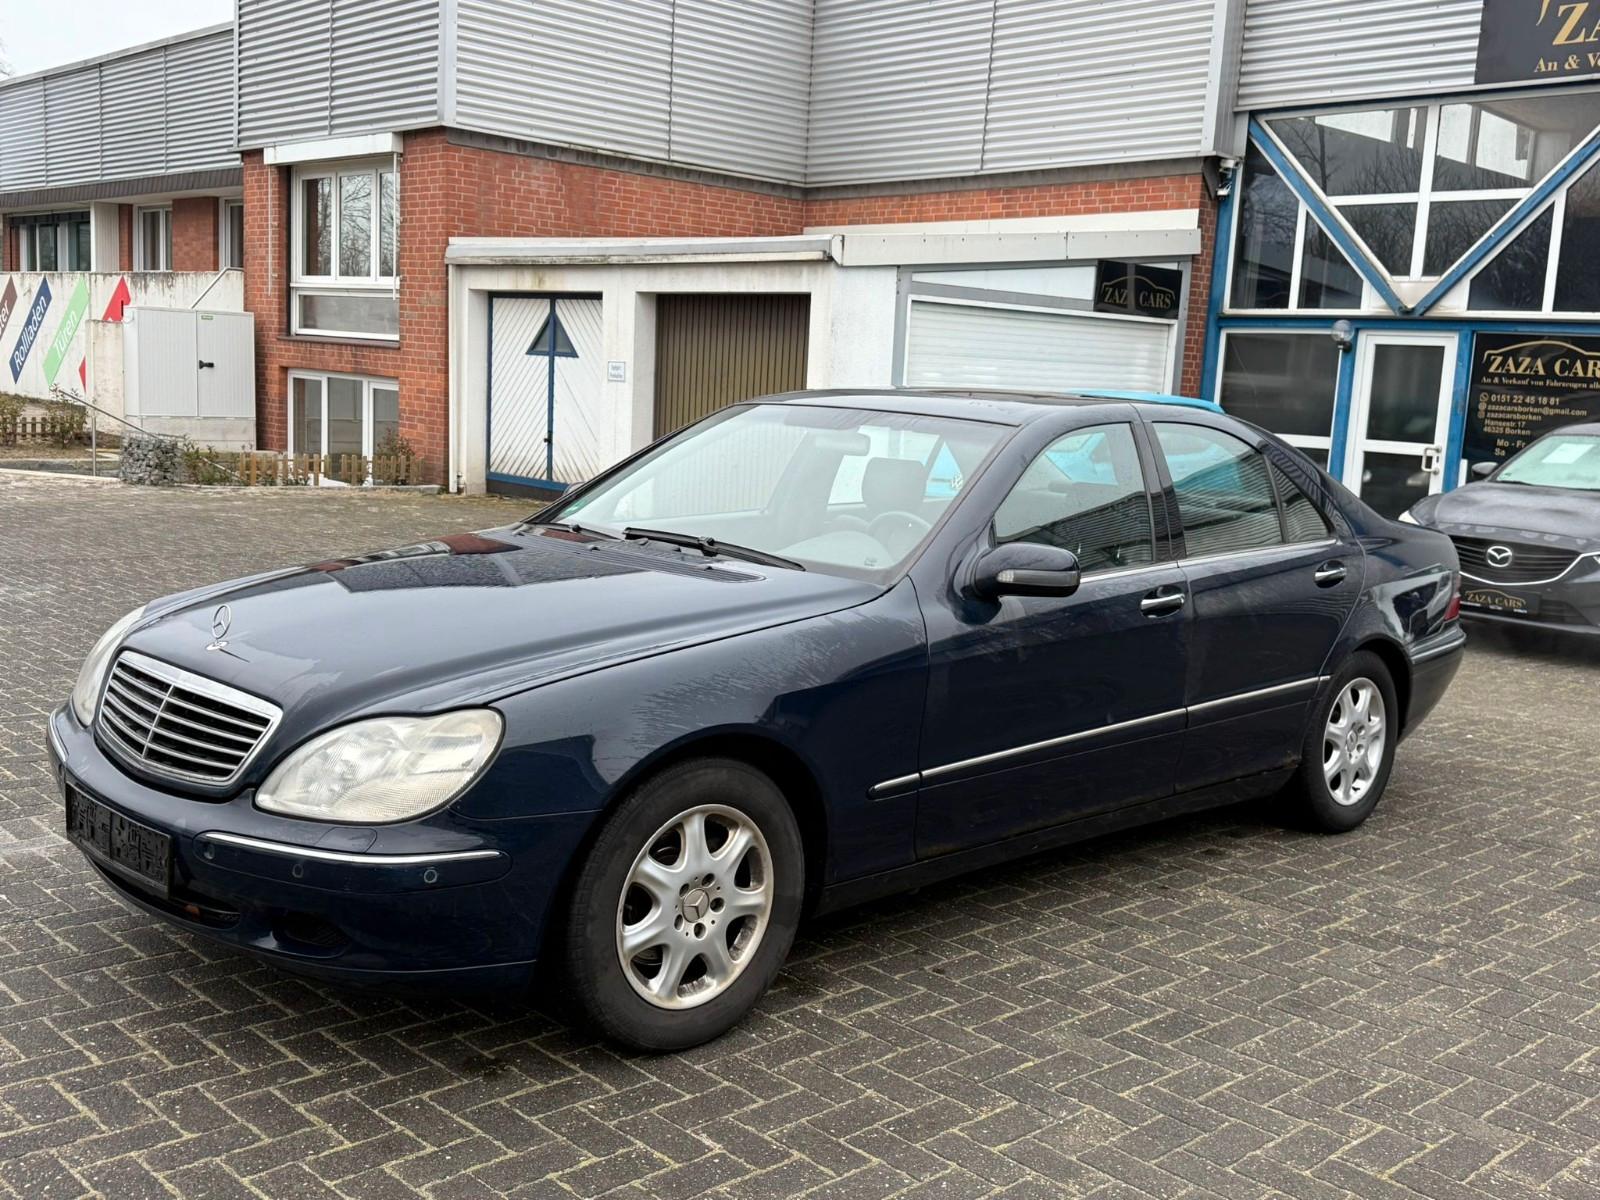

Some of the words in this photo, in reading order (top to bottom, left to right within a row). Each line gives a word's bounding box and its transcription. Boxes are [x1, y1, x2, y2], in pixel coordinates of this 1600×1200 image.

[1534, 57, 1558, 72] An
[1564, 54, 1580, 70] &
[1587, 52, 1600, 68] V
[1140, 290, 1172, 309] CARS
[13, 296, 47, 372] Rollladen
[1488, 355, 1546, 375] ZAZA
[1481, 376, 1490, 384] An
[1502, 376, 1529, 385] Verkauf
[1491, 394, 1510, 402] 0151
[1512, 395, 1523, 403] 22
[1525, 395, 1535, 404] 45
[1538, 396, 1547, 405] 18
[1487, 404, 1587, 416] zazacarsborken@gmail.com
[1486, 412, 1542, 421] zazacarsborken
[1505, 427, 1530, 435] Borken
[1496, 439, 1509, 447] Mo
[1516, 440, 1526, 448] Fr
[1494, 447, 1506, 456] Sa
[1467, 592, 1491, 604] ZAZA
[1495, 596, 1522, 609] CARS
